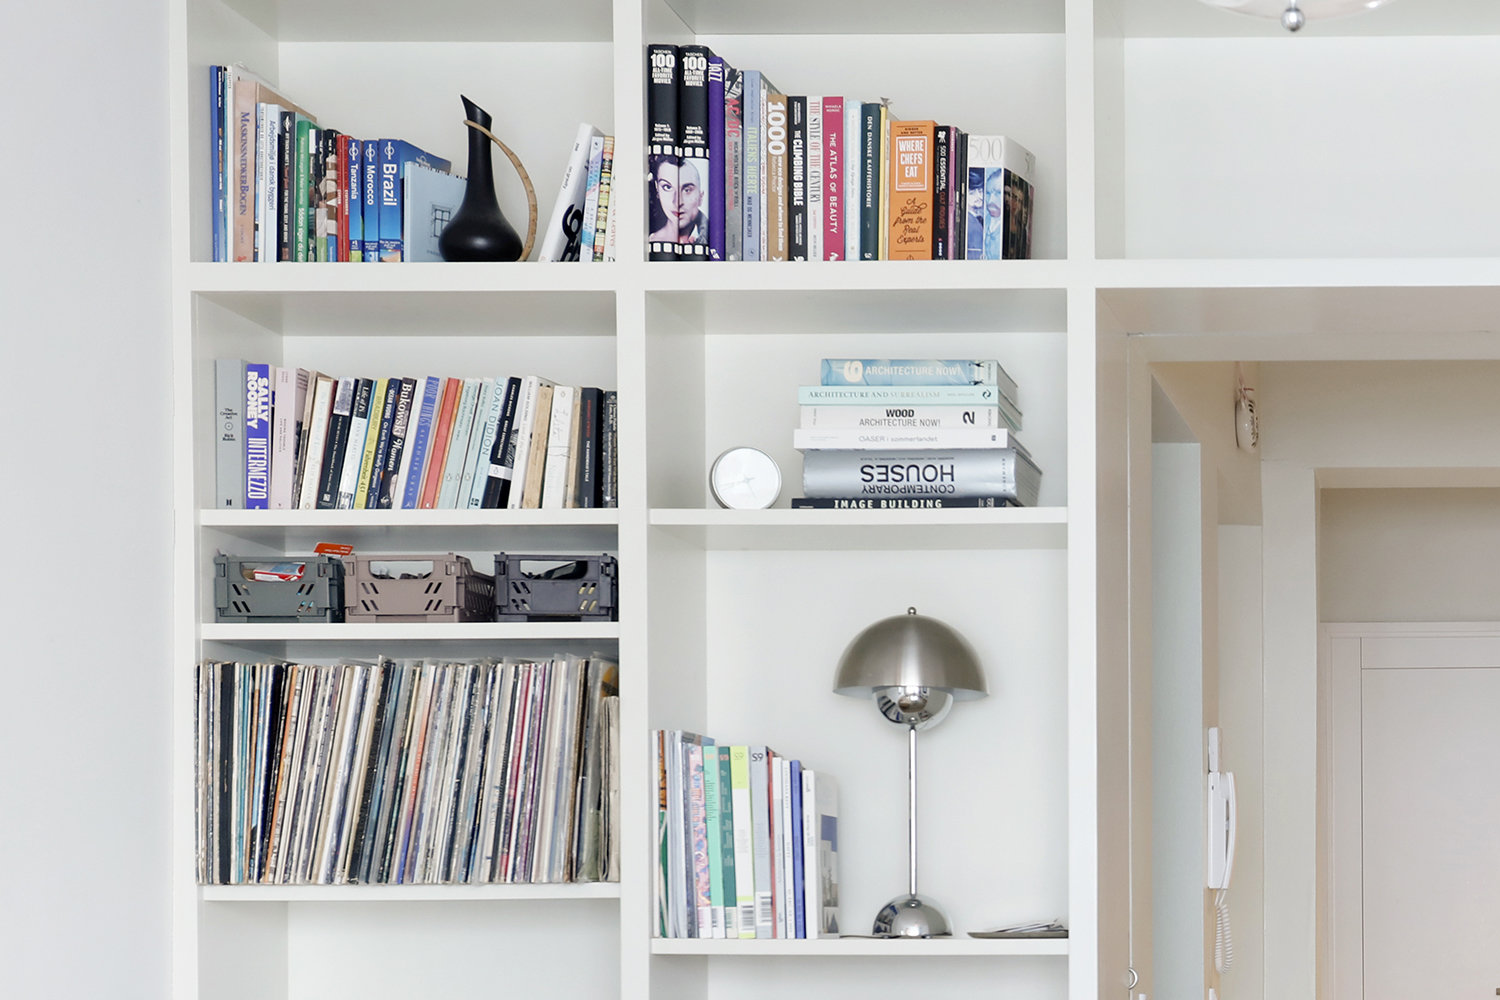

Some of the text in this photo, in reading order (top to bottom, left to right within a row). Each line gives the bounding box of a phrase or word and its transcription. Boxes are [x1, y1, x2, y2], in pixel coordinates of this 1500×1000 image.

[650, 53, 675, 68] 100
[682, 56, 707, 71] 100
[708, 62, 723, 82] JAZZ
[768, 101, 786, 155] 1000
[747, 127, 758, 162] ITALIENS
[809, 101, 821, 203] THE STYLE OF THE CENTURY
[898, 139, 924, 152] WHERE
[793, 139, 803, 181] CLIMBING
[900, 152, 923, 165] CHEFS
[350, 163, 359, 199] Tanzania
[905, 166, 919, 178] EAT
[366, 165, 376, 205] Morocco
[383, 163, 398, 206] Brazil
[793, 182, 803, 206] BIBLE
[830, 182, 836, 192] OF
[830, 196, 838, 234] BEAUTY
[865, 366, 935, 376] ARCHITECTURE
[936, 365, 962, 376] NOW!
[247, 371, 258, 430] ROONEY
[257, 377, 269, 422] SALLY
[809, 391, 870, 399] ARCHITECTURE
[393, 383, 413, 436] Bukowski
[481, 382, 504, 456] JOAN DIDION
[886, 409, 915, 418] WOOD
[859, 418, 941, 427] ARCHITECTURE NOW!
[247, 437, 267, 499] INTERMEZZO
[860, 464, 955, 482] HOUSES
[862, 484, 956, 494] CONTEMPORARY
[834, 499, 942, 509] IMAGE BUILDING
